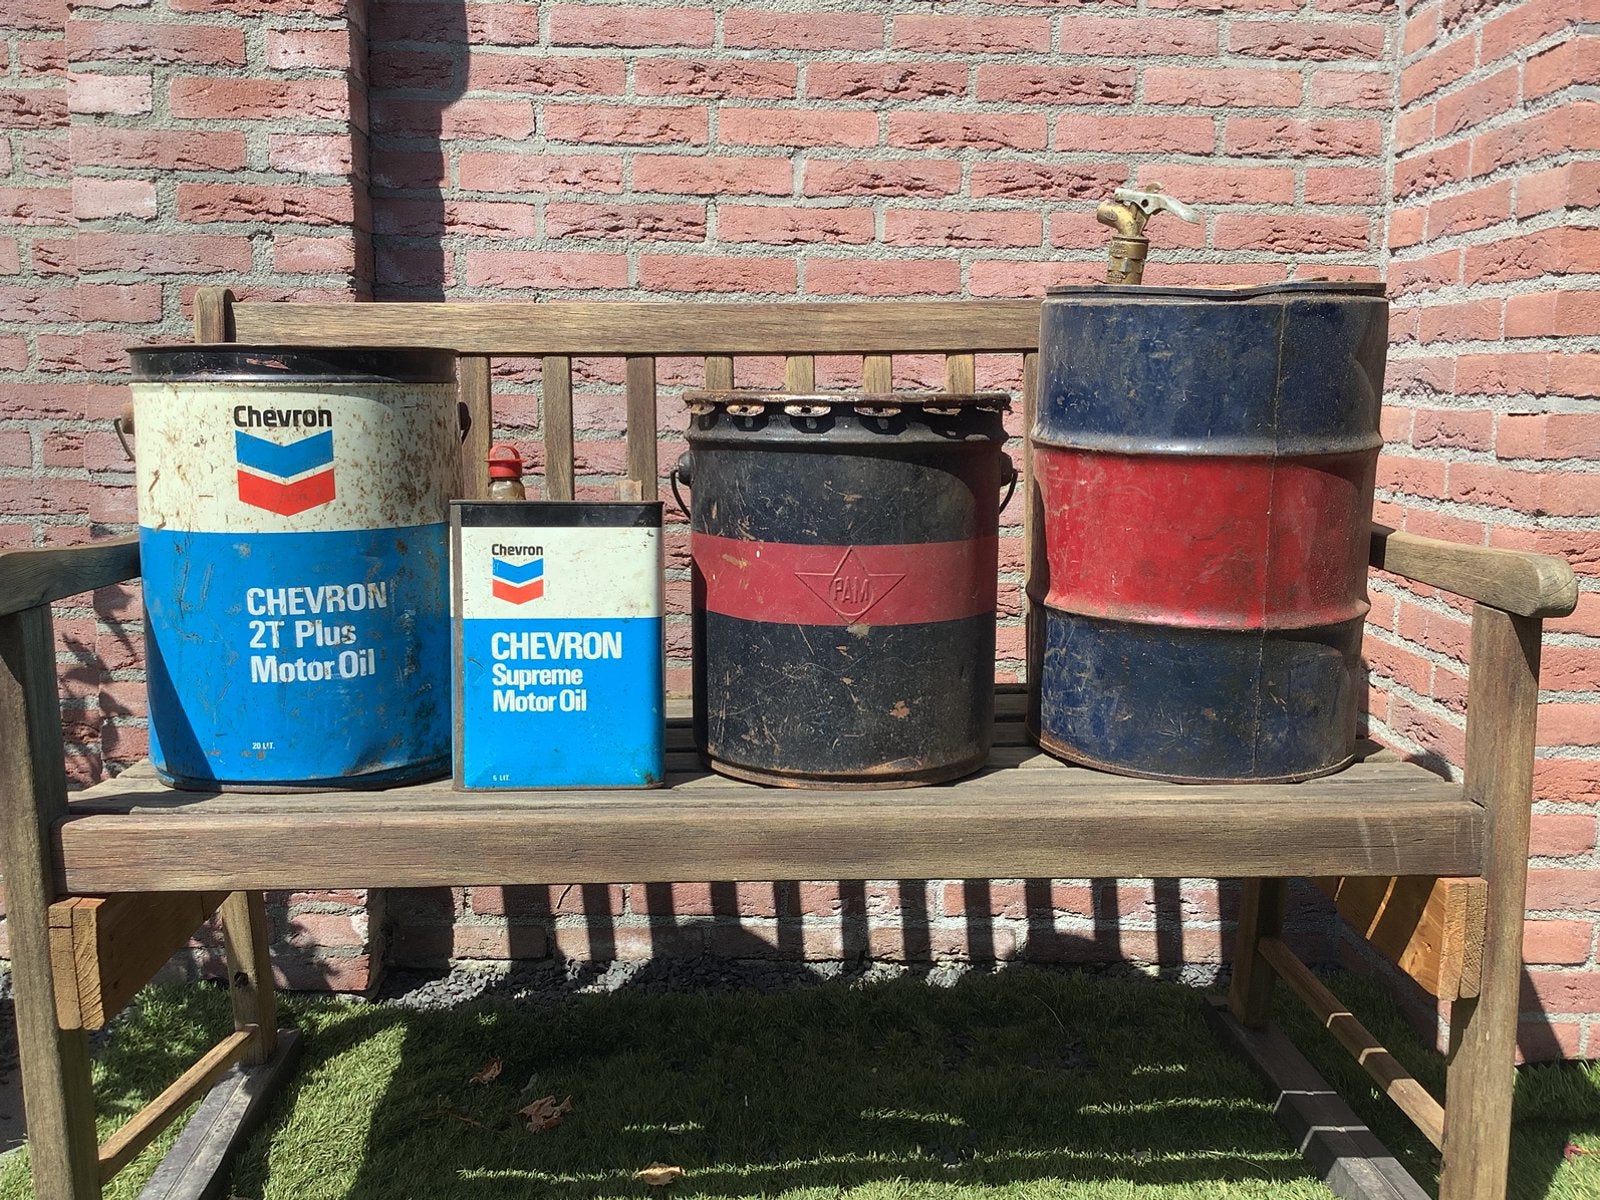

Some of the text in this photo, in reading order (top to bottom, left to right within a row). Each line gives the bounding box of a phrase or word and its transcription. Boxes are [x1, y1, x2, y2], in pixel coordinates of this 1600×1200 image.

[233, 405, 333, 428] Chevron
[491, 543, 544, 556] Chevron
[246, 581, 388, 616] CHEVRON
[833, 575, 869, 604] PAM
[249, 619, 357, 649] 2T Plus
[491, 631, 623, 660] CHEVRON
[250, 648, 376, 684] Motor Oil
[492, 663, 584, 691] Supreme
[492, 688, 587, 712] Motor Oil
[252, 742, 261, 750] 20
